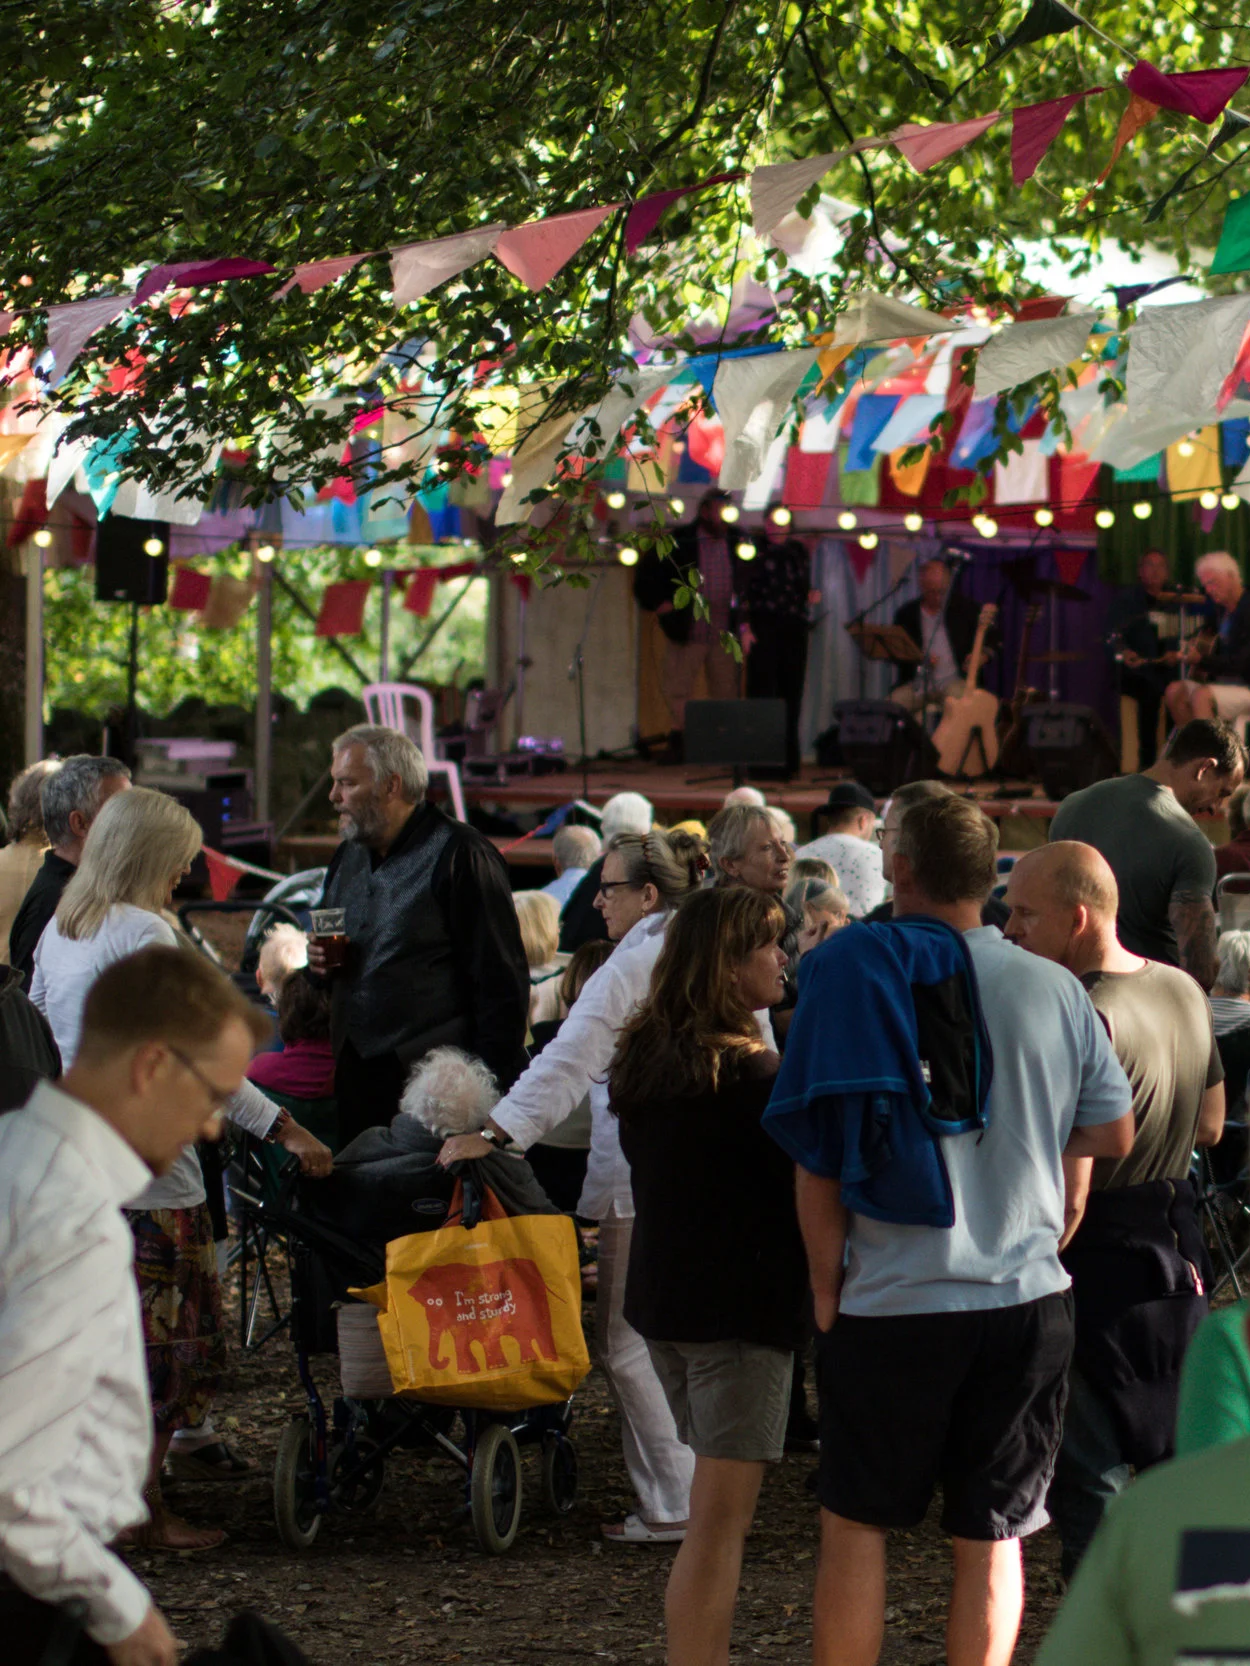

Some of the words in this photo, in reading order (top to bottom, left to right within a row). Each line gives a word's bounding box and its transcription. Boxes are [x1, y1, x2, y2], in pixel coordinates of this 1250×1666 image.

[454, 1290, 475, 1306] I'm
[478, 1289, 513, 1304] strong
[456, 1305, 476, 1321] and
[480, 1300, 516, 1320] sturdy
